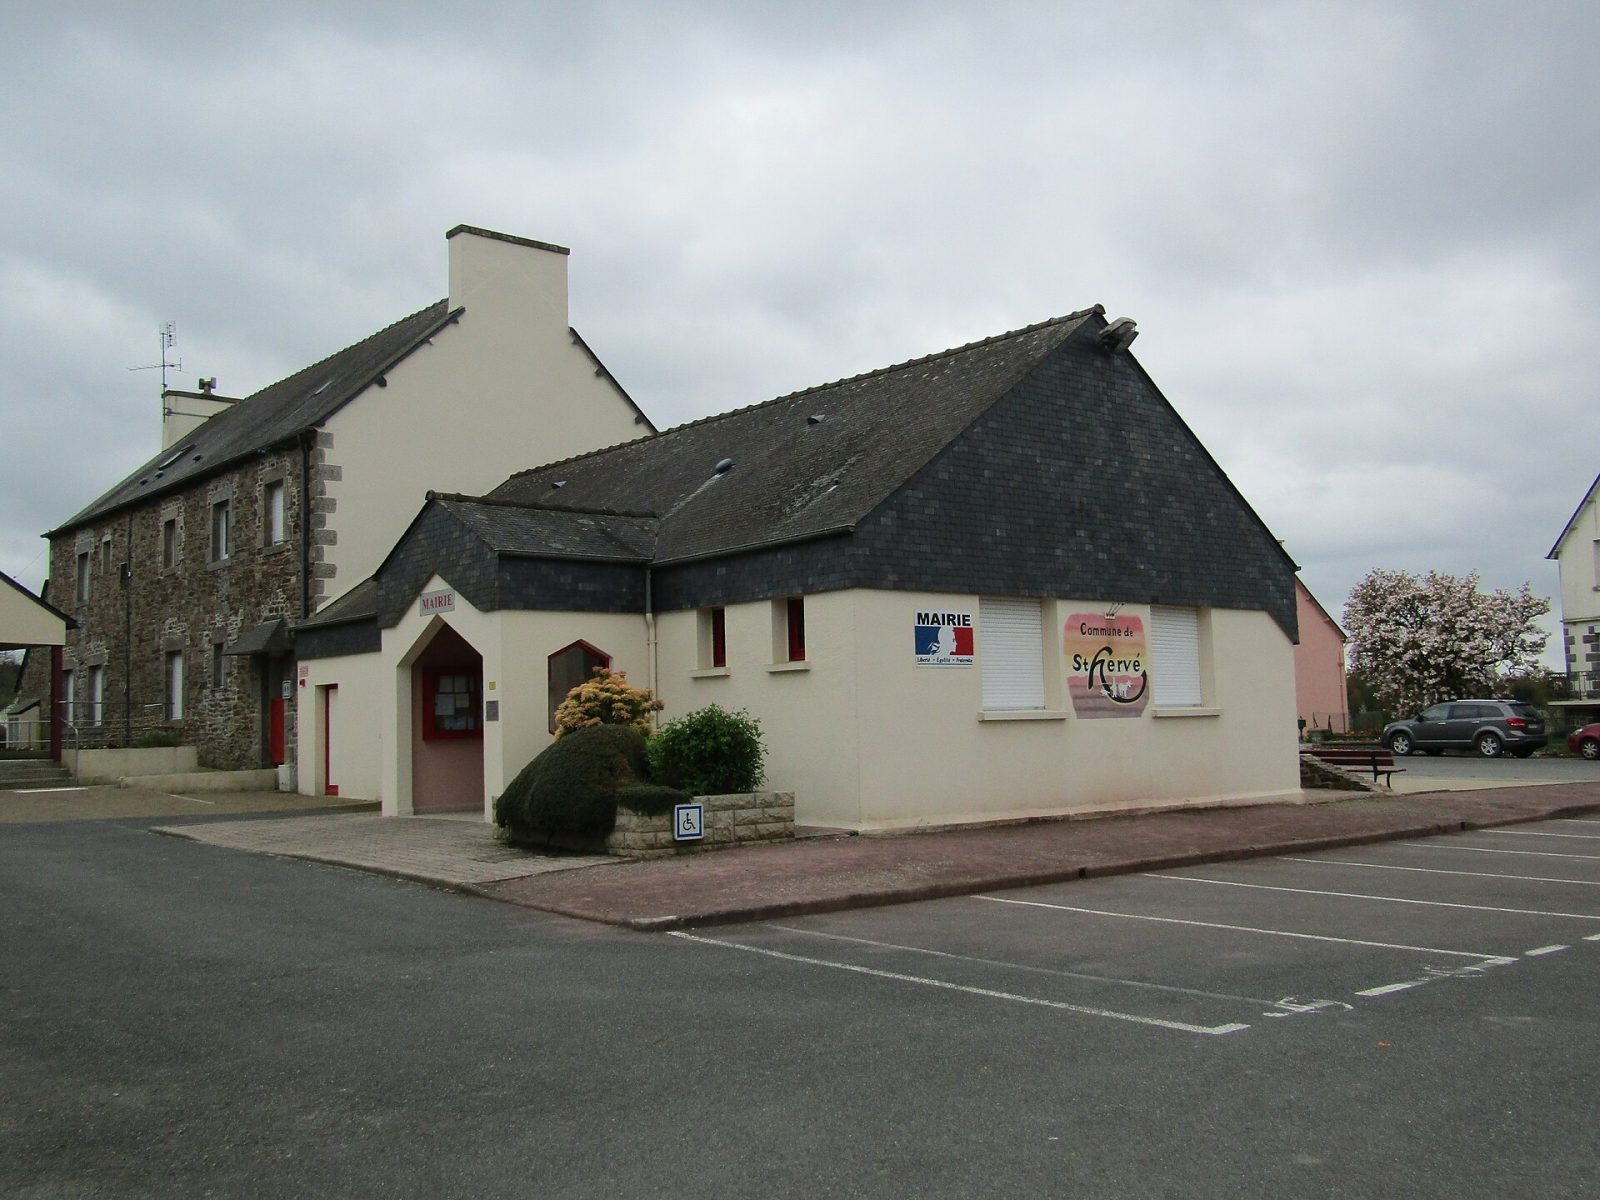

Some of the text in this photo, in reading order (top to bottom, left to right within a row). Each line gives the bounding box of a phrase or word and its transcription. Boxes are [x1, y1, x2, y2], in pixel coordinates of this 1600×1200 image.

[422, 593, 453, 610] MAIRIE
[917, 612, 971, 626] MAIRIE
[1080, 622, 1134, 637] Commune de
[1072, 653, 1089, 672] St
